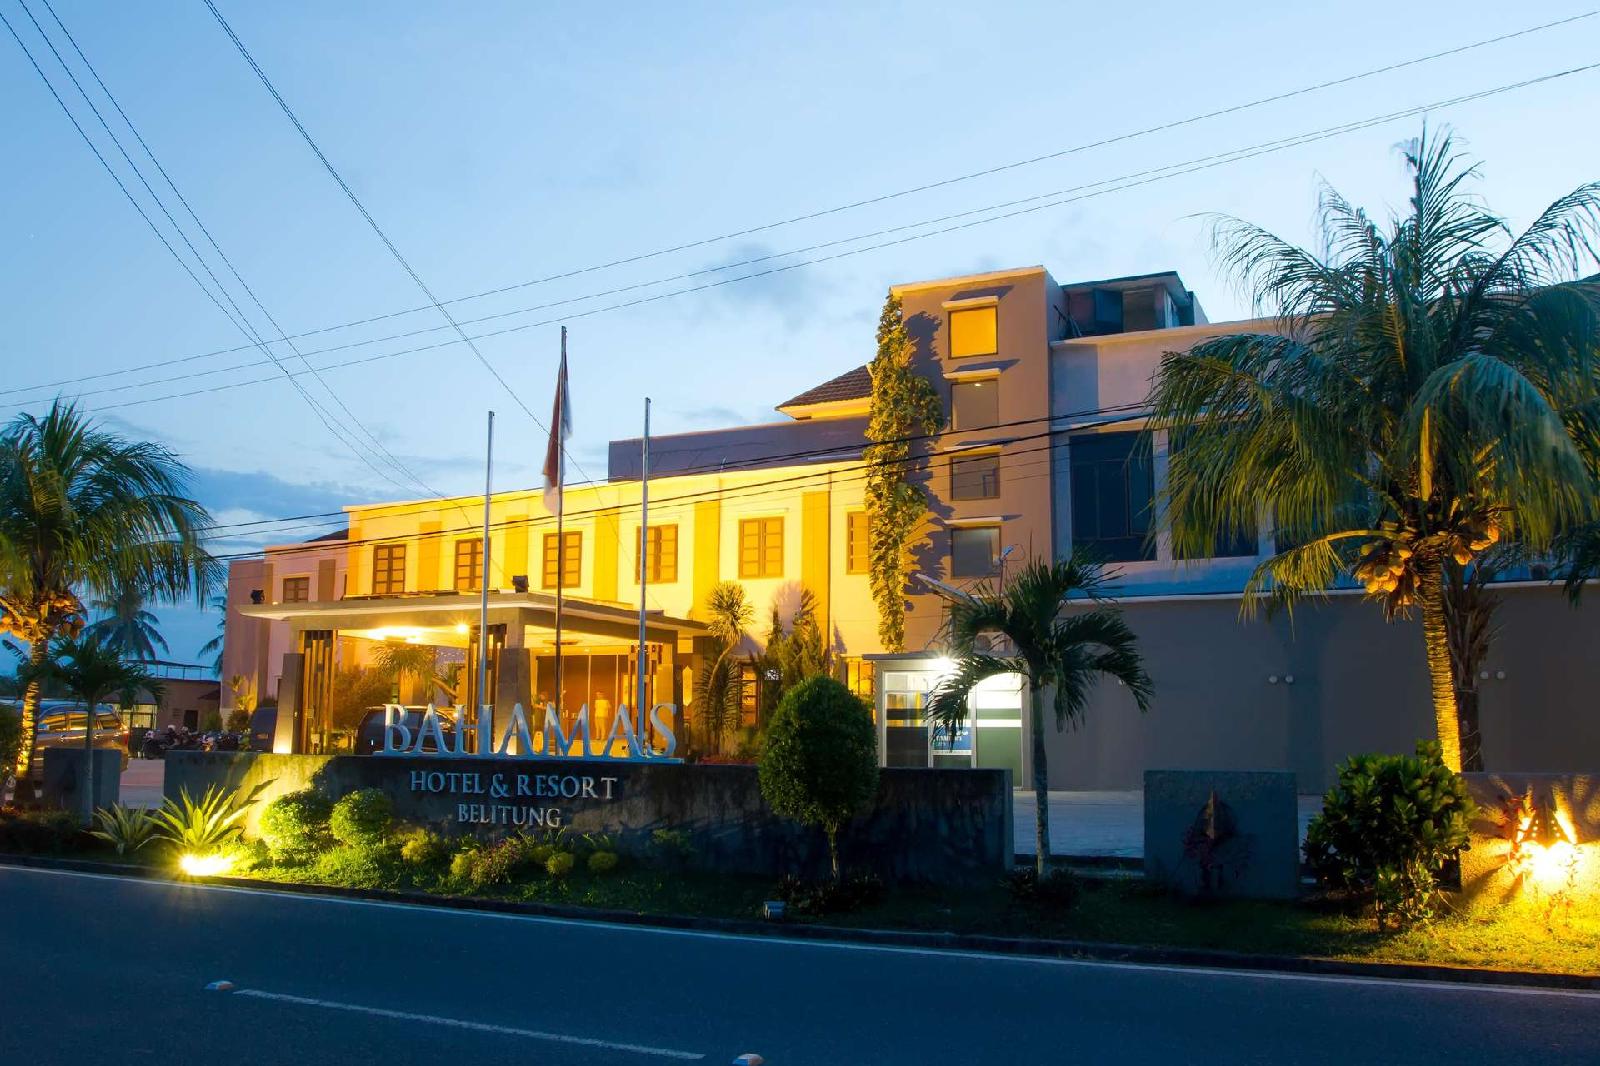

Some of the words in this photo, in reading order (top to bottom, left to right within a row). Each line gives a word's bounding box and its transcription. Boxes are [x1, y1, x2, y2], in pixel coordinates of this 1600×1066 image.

[382, 702, 677, 757] BAHAMAS
[410, 770, 485, 795] HOTEL
[489, 773, 509, 798] &
[517, 775, 617, 799] RESORT
[457, 803, 561, 828] BELITUNG
